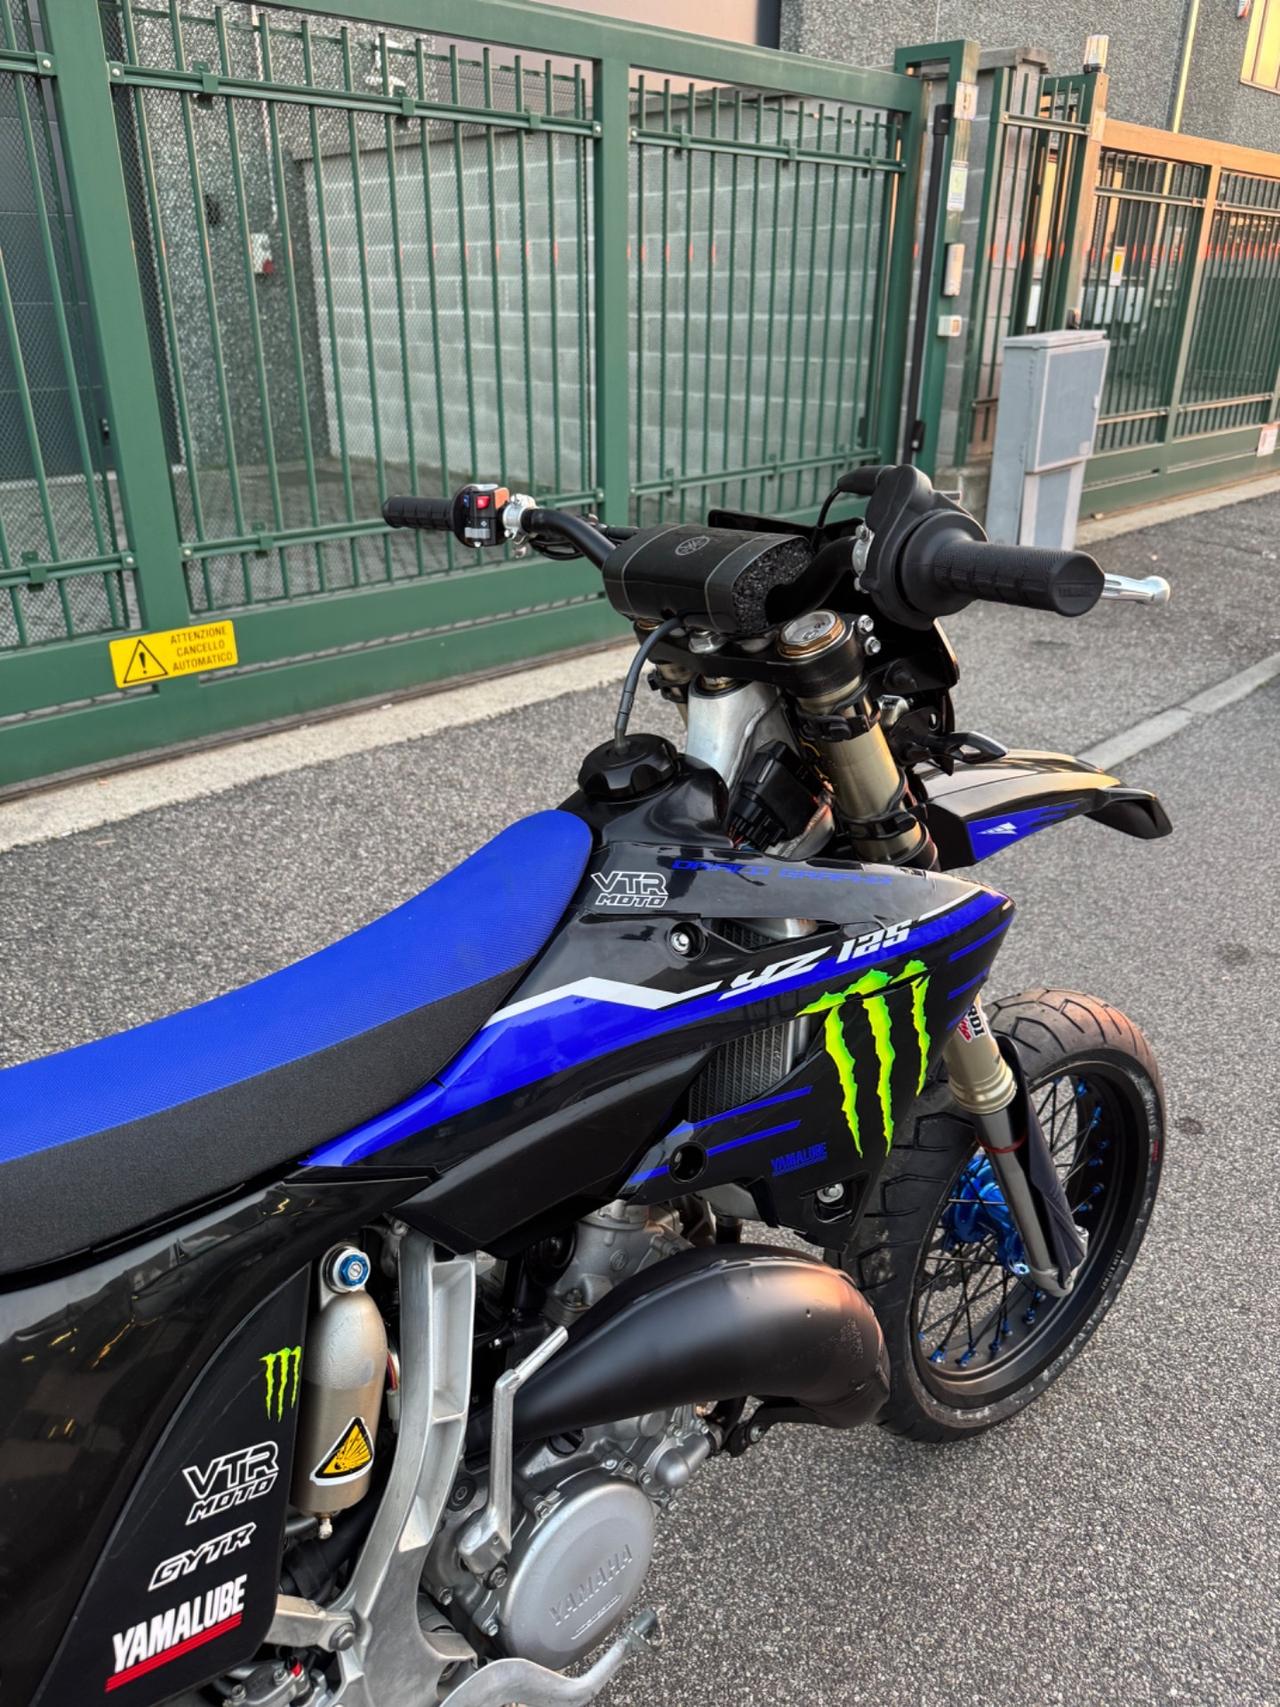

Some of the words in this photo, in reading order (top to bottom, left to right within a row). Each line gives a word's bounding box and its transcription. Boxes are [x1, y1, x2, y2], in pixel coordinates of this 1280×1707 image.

[170, 625, 227, 645] ATTENZIONE
[172, 651, 233, 672] AUTOMATICO
[176, 639, 225, 657] CANCELLO
[590, 870, 669, 896] VTR
[594, 893, 669, 909] MOTO
[717, 945, 833, 1002] YZ
[836, 919, 913, 965] 125
[181, 1440, 280, 1500] VTR
[185, 1471, 279, 1526] MOTO
[147, 1521, 257, 1592] GYTR
[548, 1543, 633, 1627] YAMAHA
[112, 1573, 248, 1676] YAMALUBE
